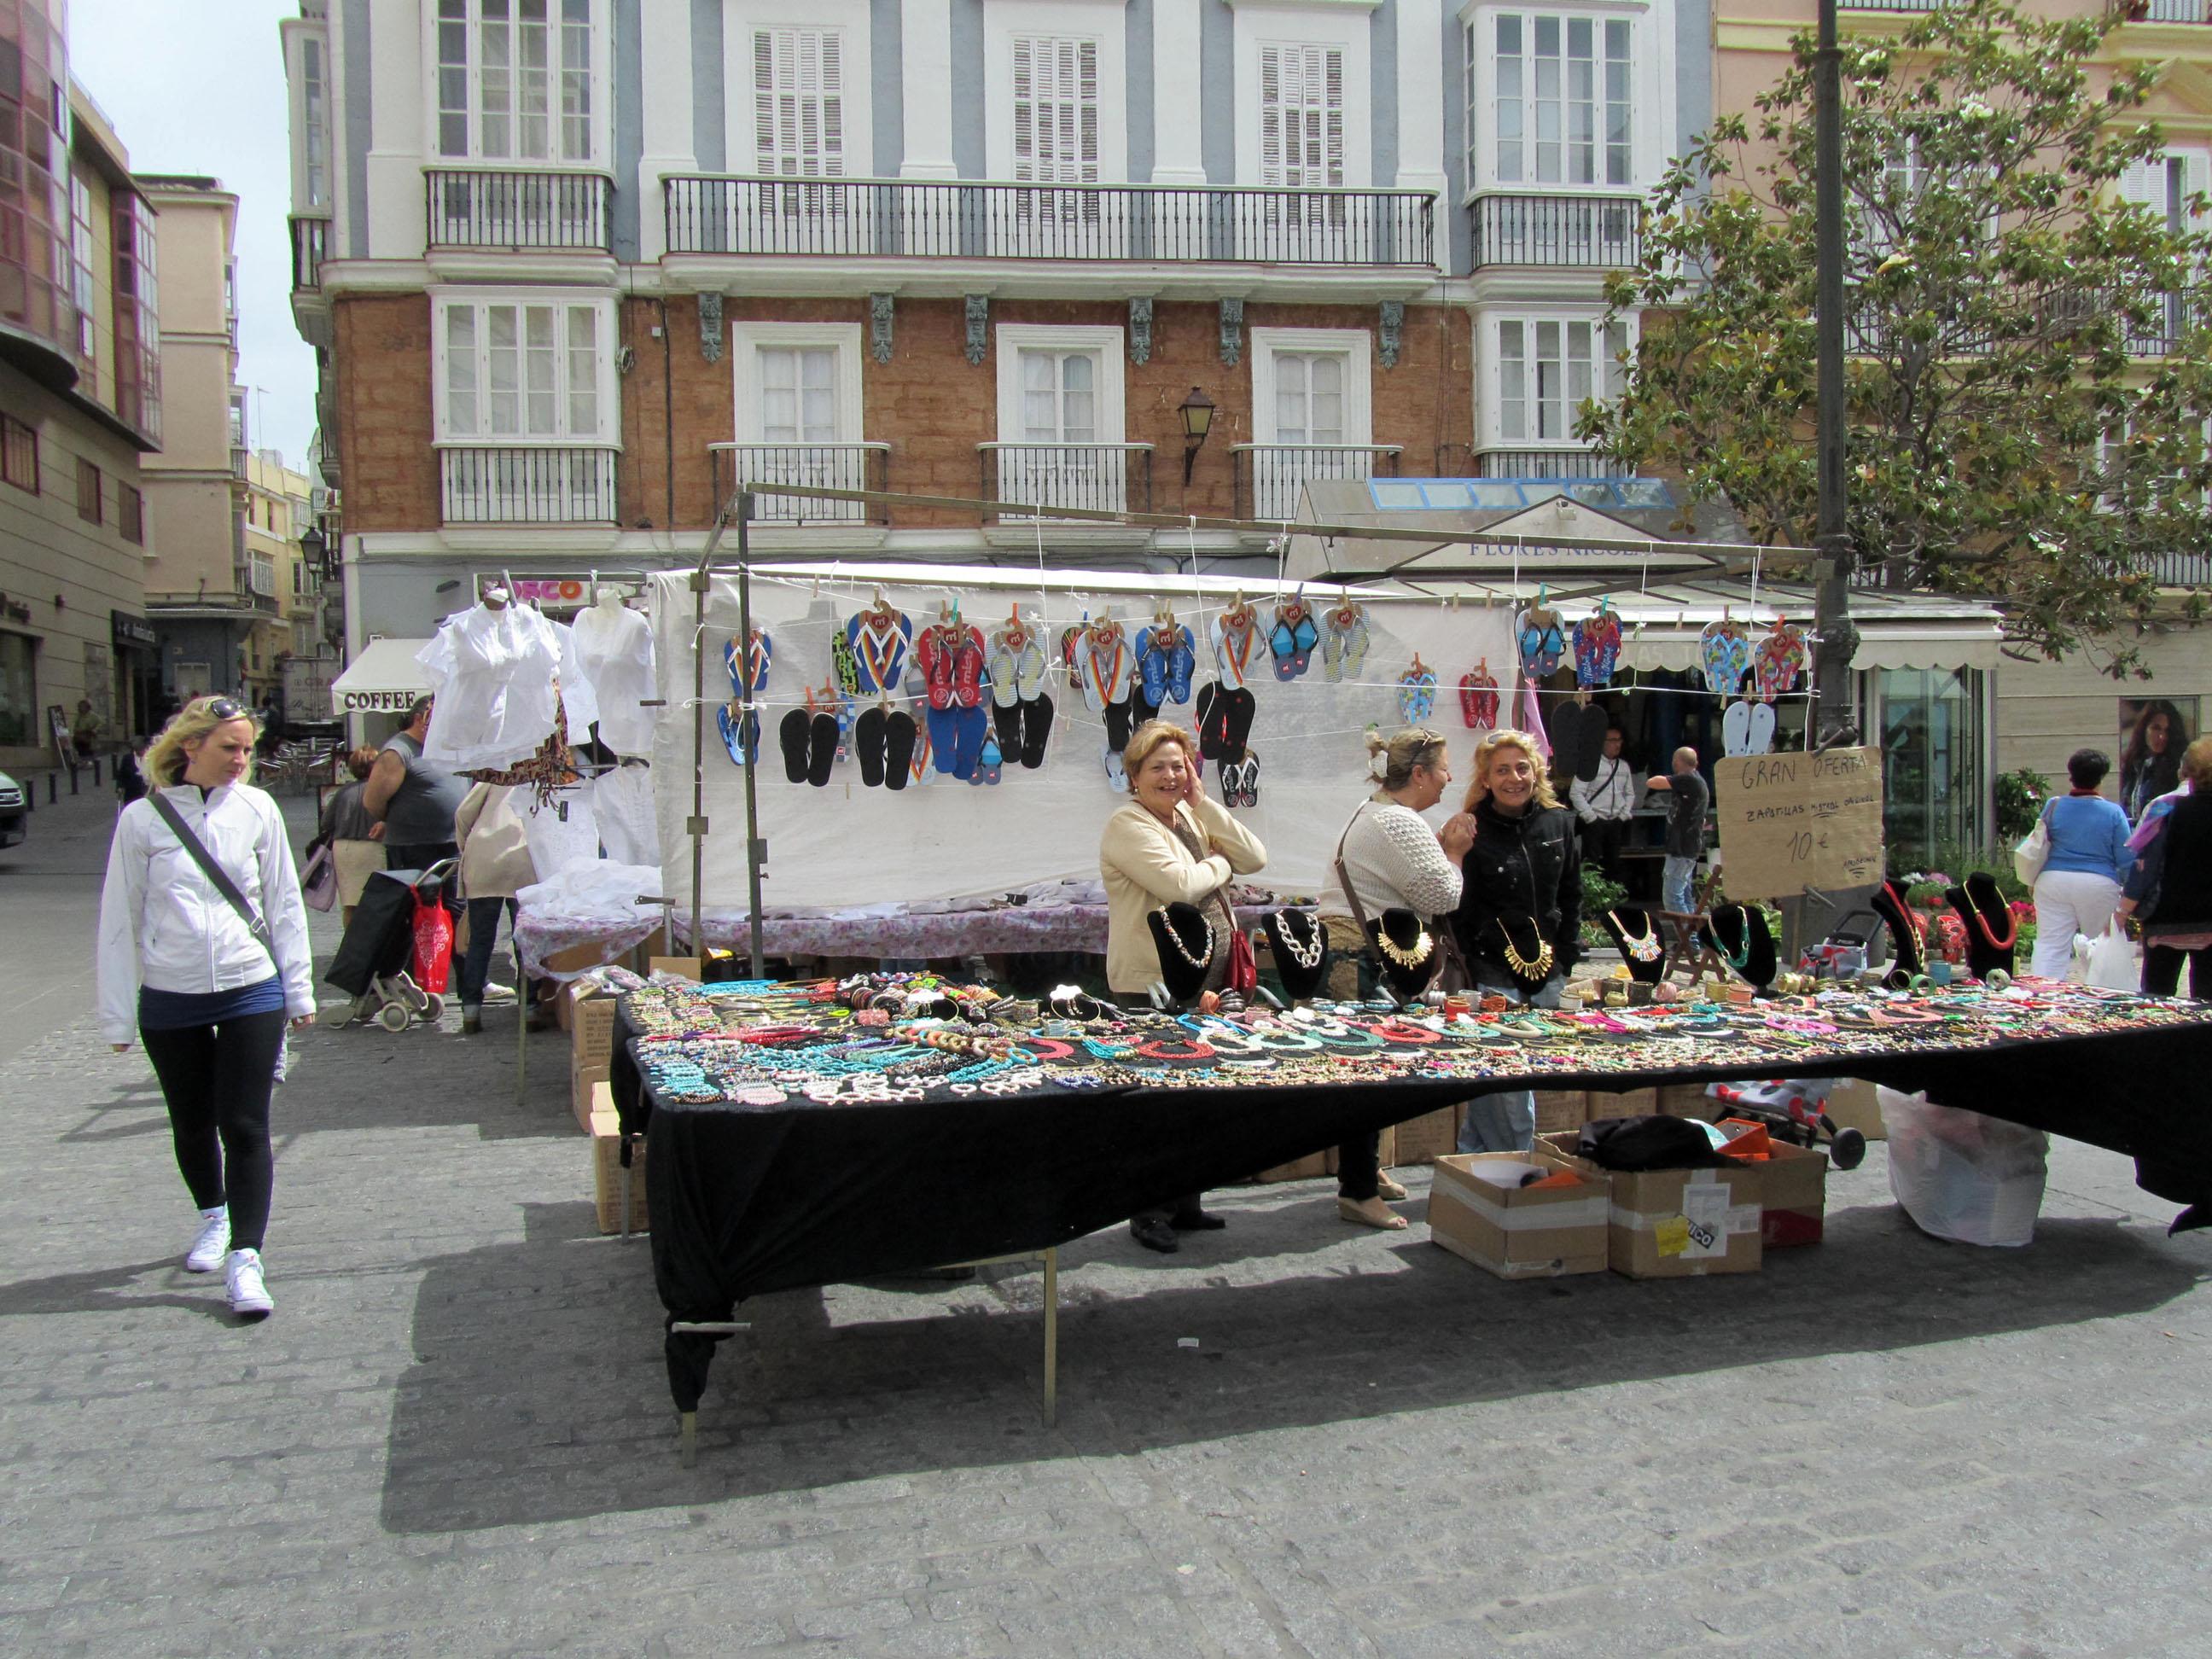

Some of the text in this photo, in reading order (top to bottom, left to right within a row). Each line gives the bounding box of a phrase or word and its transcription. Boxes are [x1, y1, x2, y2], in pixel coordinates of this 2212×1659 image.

[1742, 754, 1867, 789] GRAN OFERTA
[1786, 830, 1813, 863] 10
[1689, 1221, 1712, 1246] ICO
